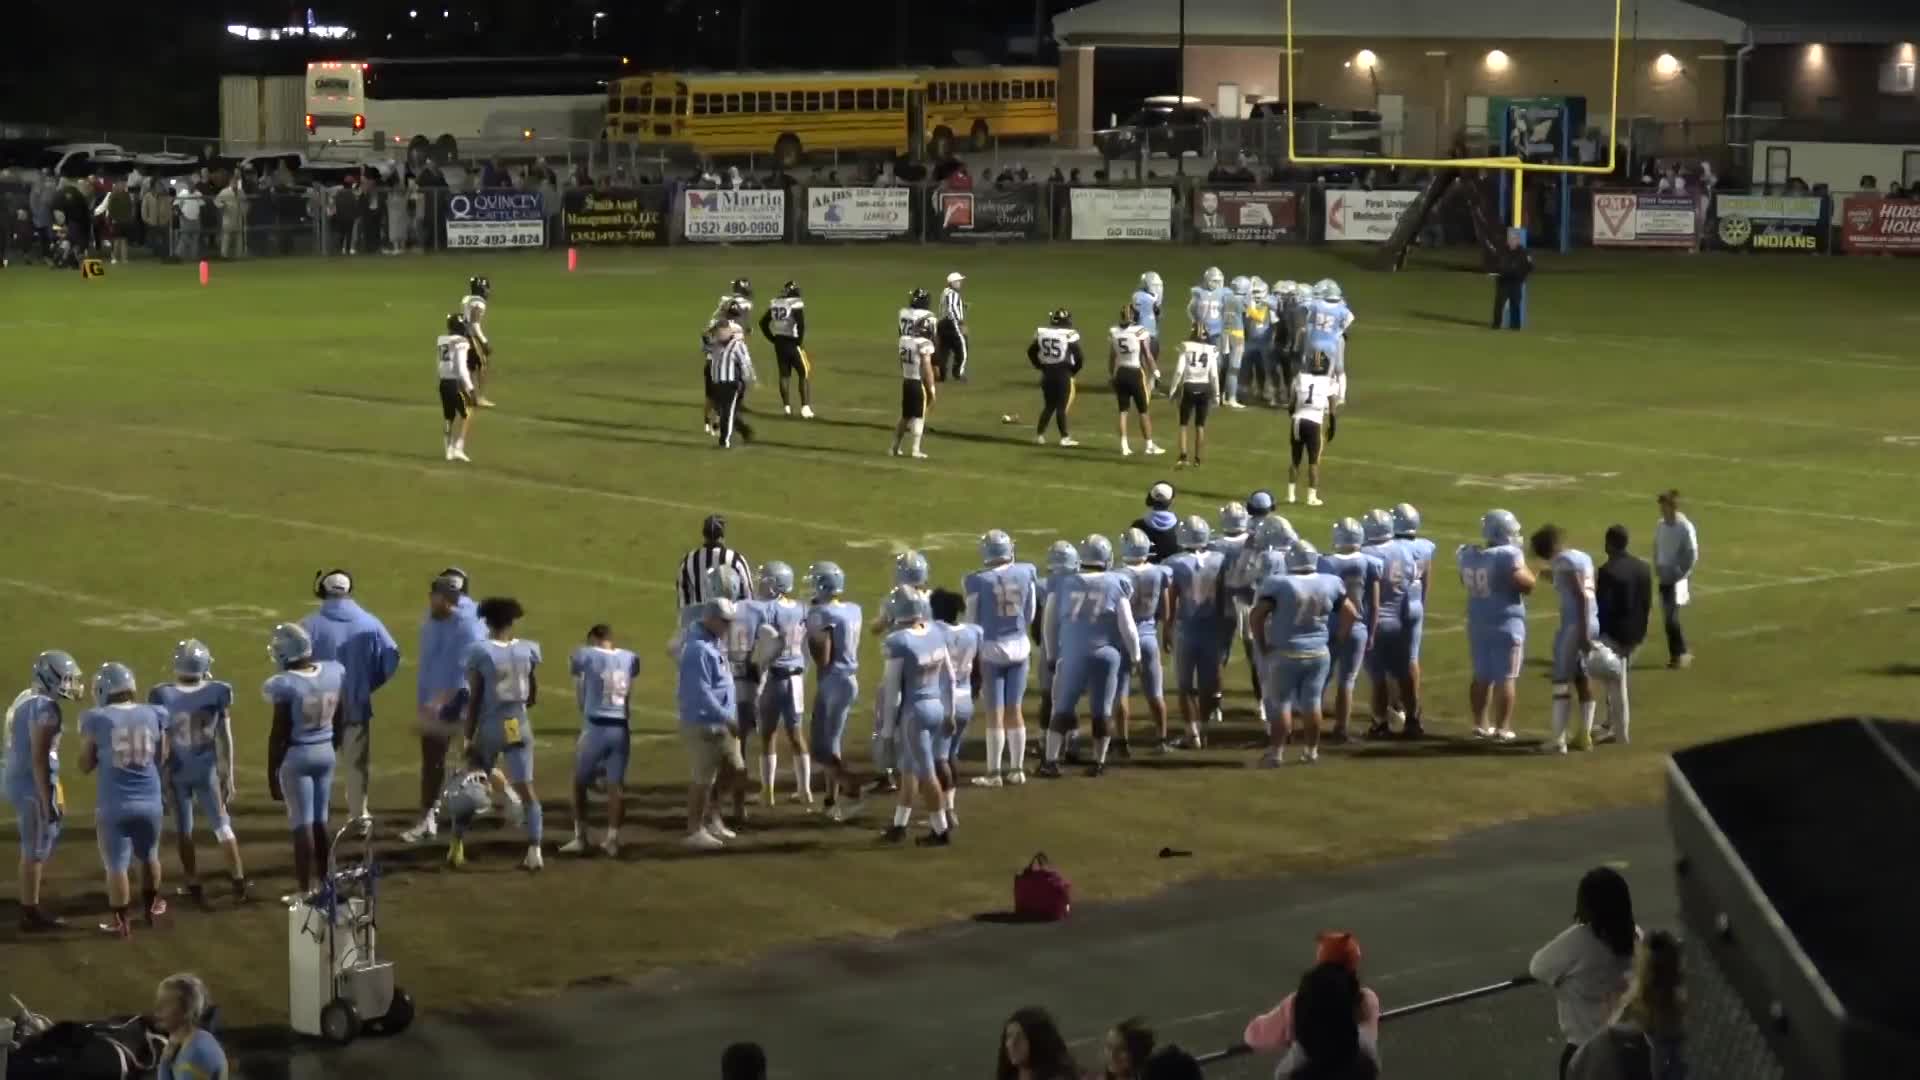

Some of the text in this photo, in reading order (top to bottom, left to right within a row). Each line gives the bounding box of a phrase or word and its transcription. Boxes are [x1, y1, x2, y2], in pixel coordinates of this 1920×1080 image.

[475, 194, 541, 209] QUINCEY
[722, 191, 782, 207] Martin
[1753, 234, 1817, 249] INDIANS
[1041, 337, 1062, 358] 55
[1118, 338, 1130, 354] 5
[1191, 350, 1209, 368] 14
[1303, 382, 1316, 405] 1
[1069, 591, 1106, 625] 77
